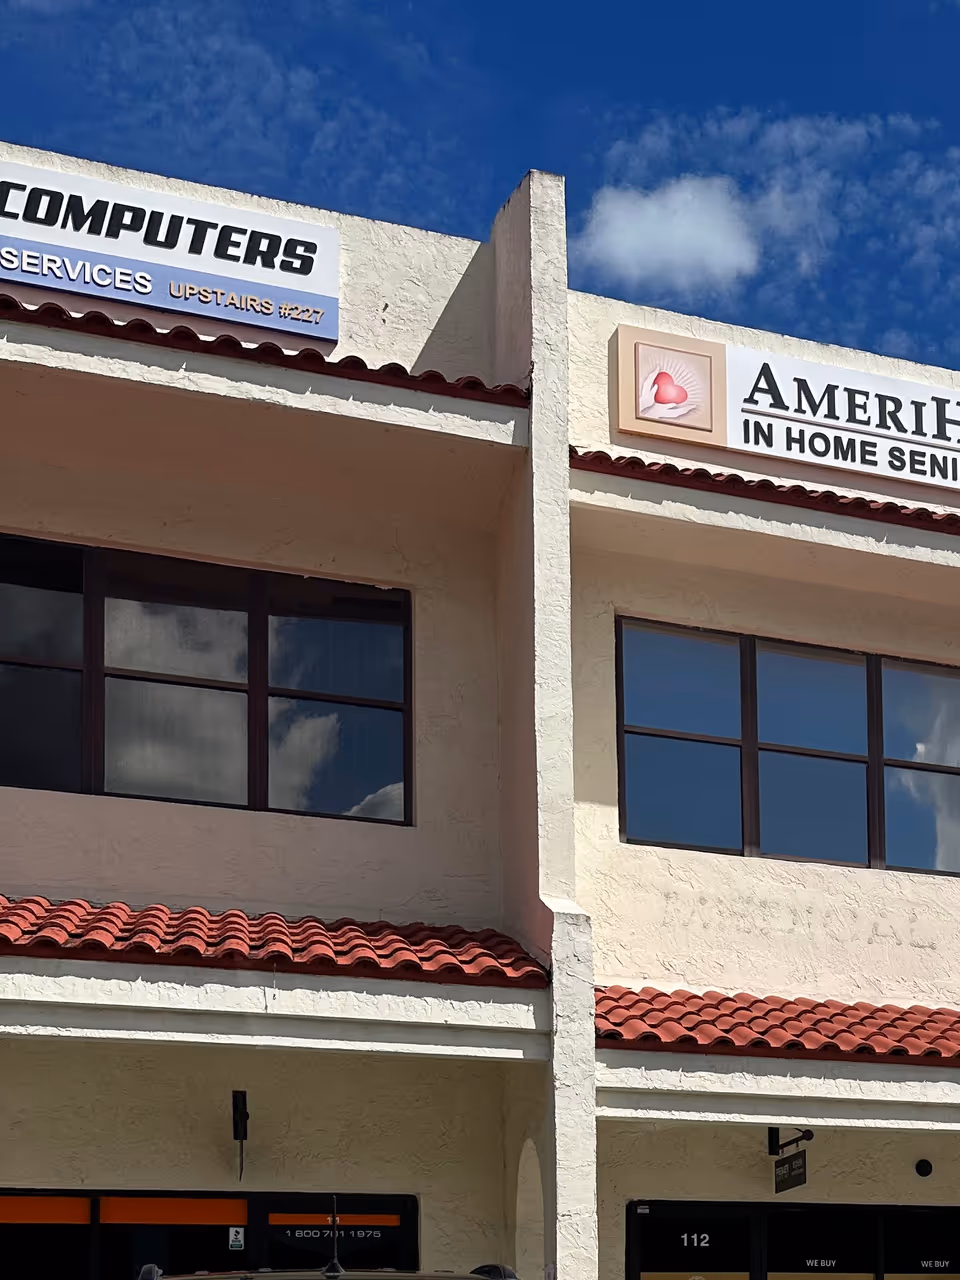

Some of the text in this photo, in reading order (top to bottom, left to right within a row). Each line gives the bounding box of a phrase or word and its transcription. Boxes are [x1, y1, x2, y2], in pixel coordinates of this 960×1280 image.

[0, 180, 318, 277] COMPUTERS
[0, 247, 325, 325] SERVICES UPSTAIRS #227
[743, 418, 775, 448] IN
[785, 425, 879, 466] HOME
[286, 1230, 291, 1238] 1
[295, 1230, 320, 1238] 800
[349, 1230, 381, 1238] 1975
[681, 1233, 710, 1247] 112
[806, 1259, 837, 1267] WE BUY
[921, 1260, 950, 1268] WE BUY
